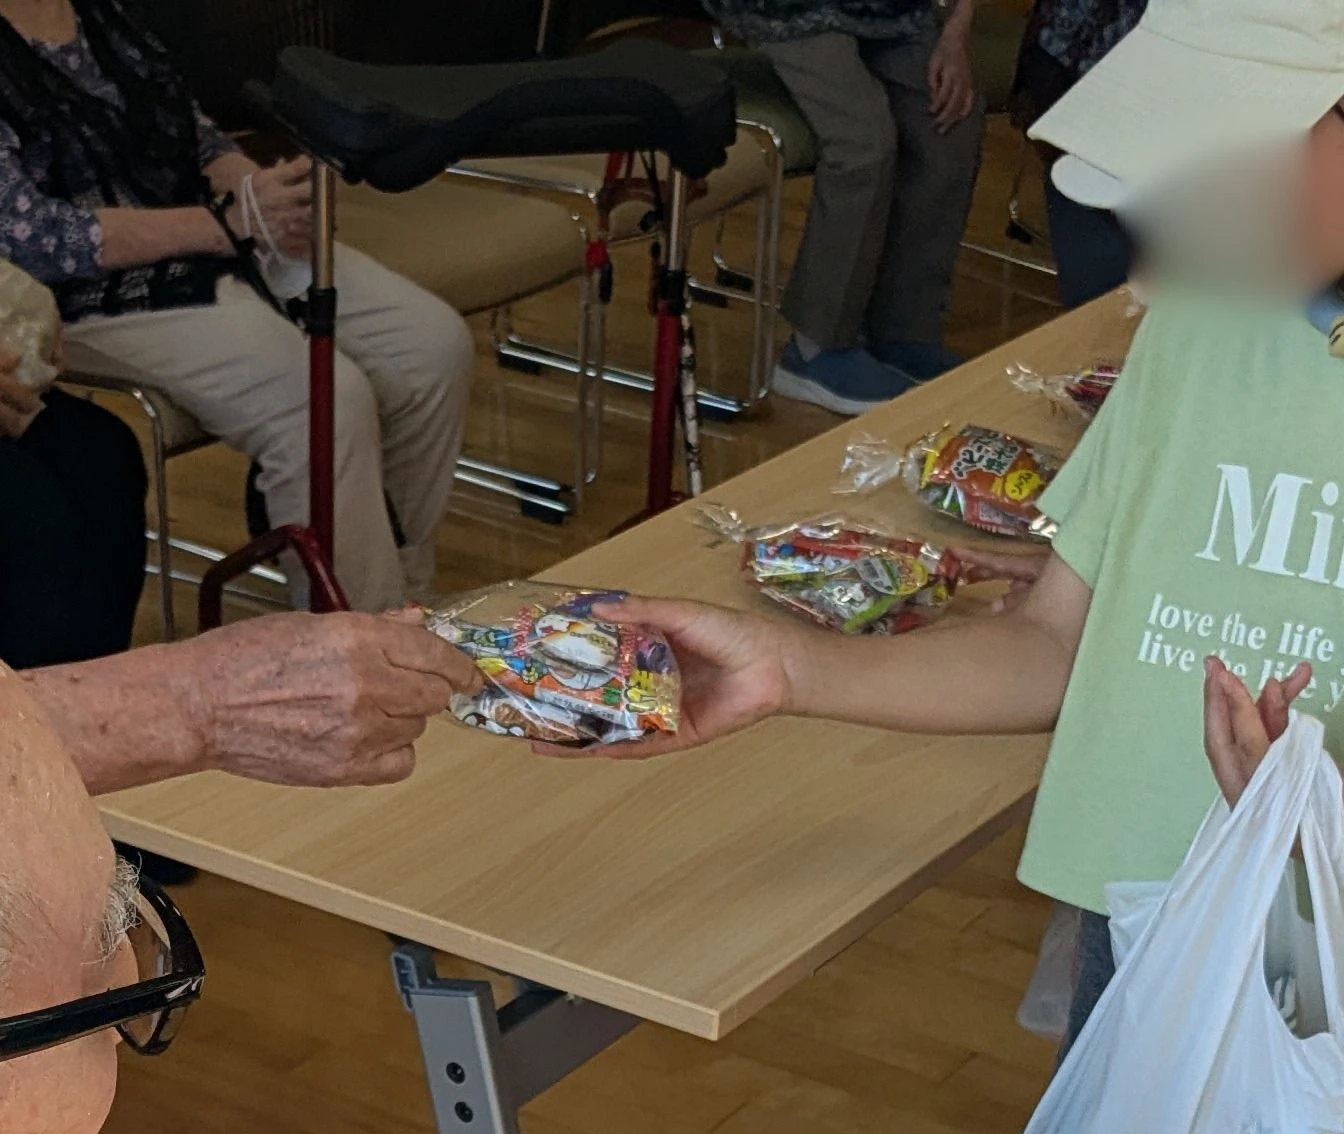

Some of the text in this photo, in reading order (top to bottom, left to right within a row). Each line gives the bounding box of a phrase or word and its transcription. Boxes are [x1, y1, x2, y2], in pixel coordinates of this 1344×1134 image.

[1137, 631, 1196, 673] live
[1147, 593, 1213, 637] love
[1221, 612, 1267, 650] the
[1277, 622, 1335, 663] life
